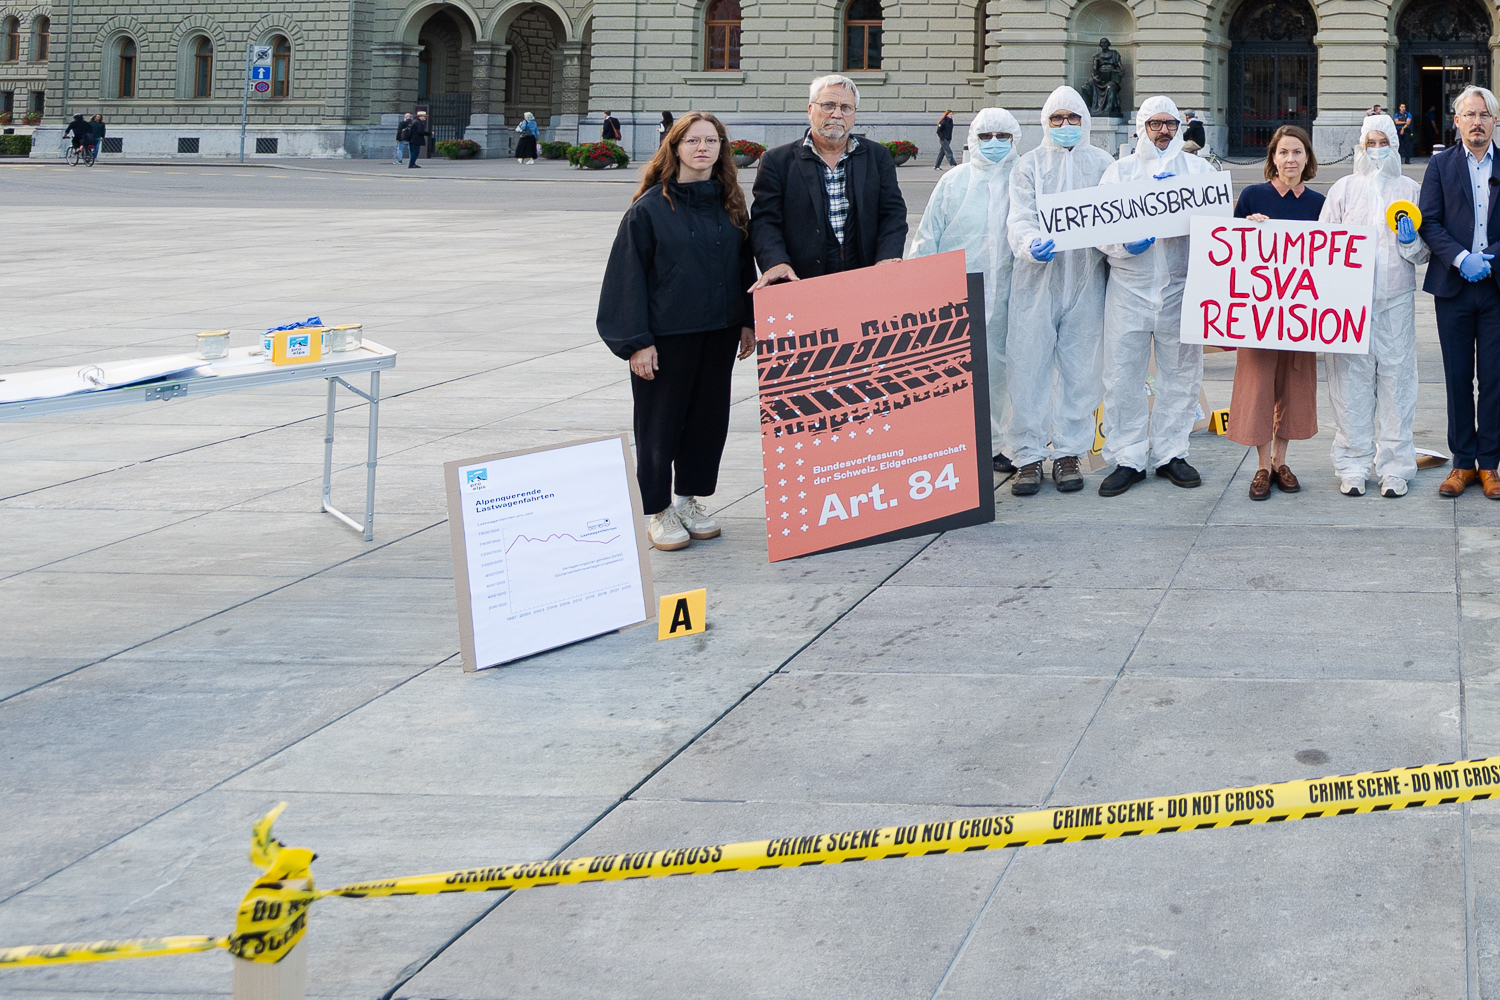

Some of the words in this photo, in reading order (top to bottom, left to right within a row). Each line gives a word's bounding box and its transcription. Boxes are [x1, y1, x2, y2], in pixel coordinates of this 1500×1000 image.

[1039, 183, 1231, 235] VERFASSUNGSBRUCH
[1208, 226, 1368, 269] STUMPFE
[1228, 266, 1319, 301] LSVA
[1200, 300, 1367, 345] REVISION
[813, 449, 904, 475] Bundesverfassung
[814, 475, 832, 486] der
[880, 444, 967, 471] Eidgenossenschaft
[475, 488, 542, 507] Alpenquerende
[476, 492, 555, 514] Lastwagenfahrten
[818, 483, 899, 527] Art.
[908, 463, 960, 500] 84
[669, 598, 693, 634] A
[1309, 781, 1354, 804] CRIME
[1358, 776, 1401, 799] SCENE
[1411, 773, 1430, 793] DO
[1434, 769, 1460, 791] NOT
[1053, 806, 1103, 830] CRIME
[1107, 801, 1154, 825] SCENE
[1167, 798, 1188, 819] DO
[1193, 795, 1221, 816] NOT
[1225, 789, 1275, 812] CROSS
[766, 834, 822, 858] CRIME
[827, 829, 883, 852] SCENE
[894, 825, 919, 846] DO
[921, 821, 957, 843] NOT
[959, 816, 1015, 839] CROSS
[588, 856, 618, 874] DO
[619, 852, 656, 872] NOT
[662, 845, 723, 868] CROSS
